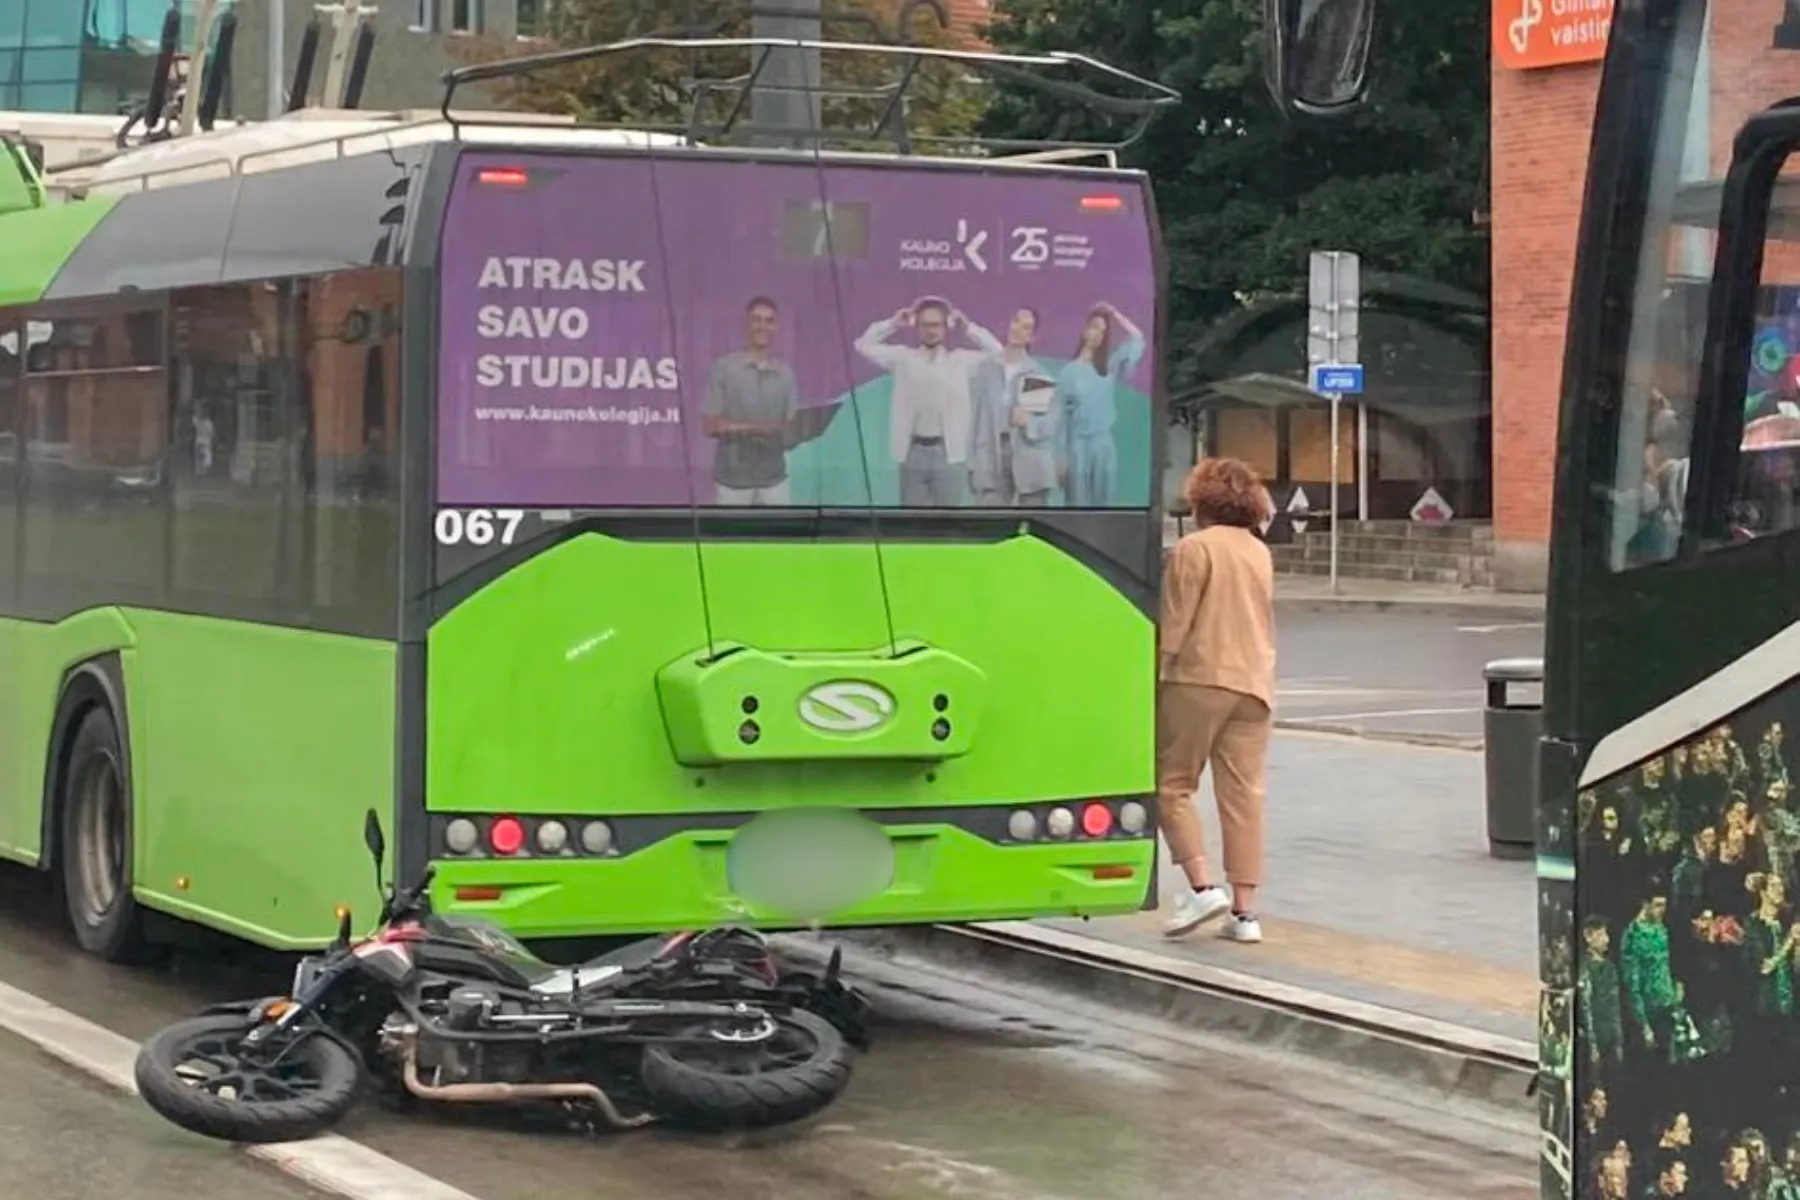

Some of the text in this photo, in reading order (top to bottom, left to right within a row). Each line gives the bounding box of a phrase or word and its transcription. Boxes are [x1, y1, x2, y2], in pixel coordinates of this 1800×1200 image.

[1009, 226, 1049, 262] 25
[477, 256, 647, 292] ATRASK
[476, 304, 590, 340] SAVO
[475, 353, 679, 390] STUDIJAS
[434, 508, 525, 545] 067
